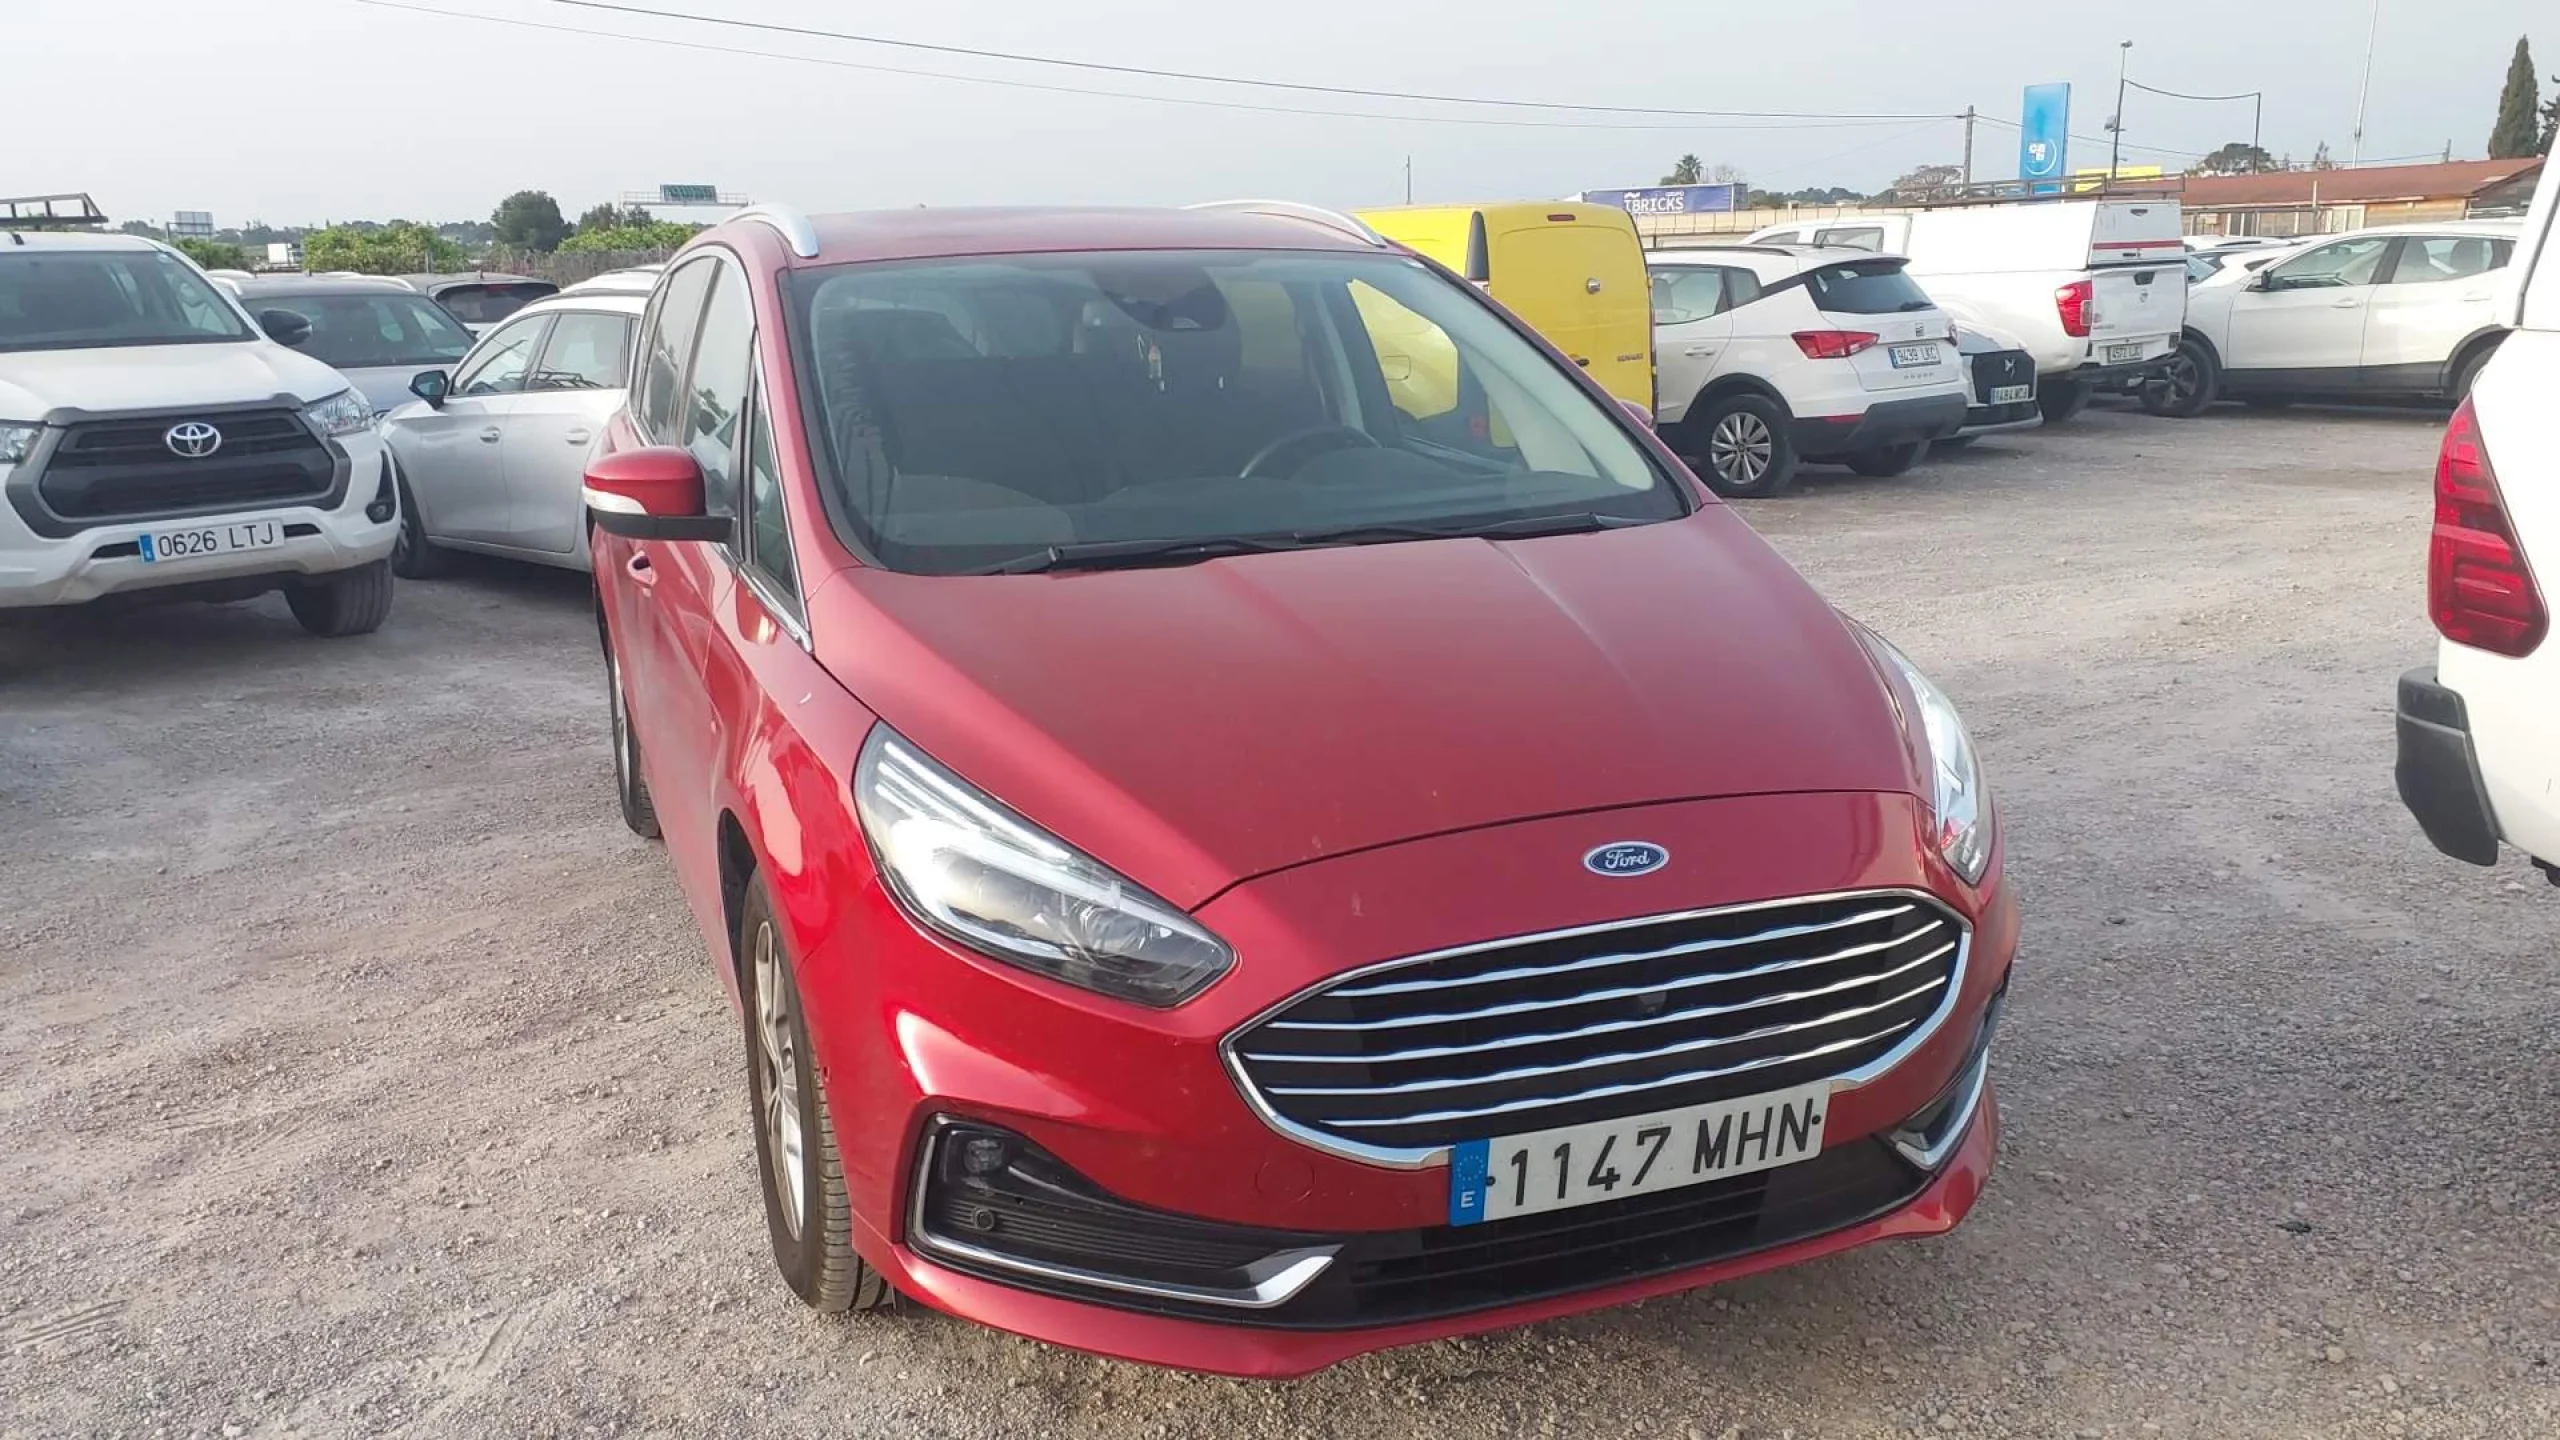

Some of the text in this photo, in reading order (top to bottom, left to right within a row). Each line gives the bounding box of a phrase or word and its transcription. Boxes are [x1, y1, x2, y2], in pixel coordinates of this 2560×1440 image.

[1898, 347, 1919, 362] 9439
[158, 522, 274, 557] 0626 LTJ
[1604, 847, 1651, 869] Ford
[1511, 1098, 1814, 1206] 1147 MHN
[1460, 1191, 1476, 1209] E
